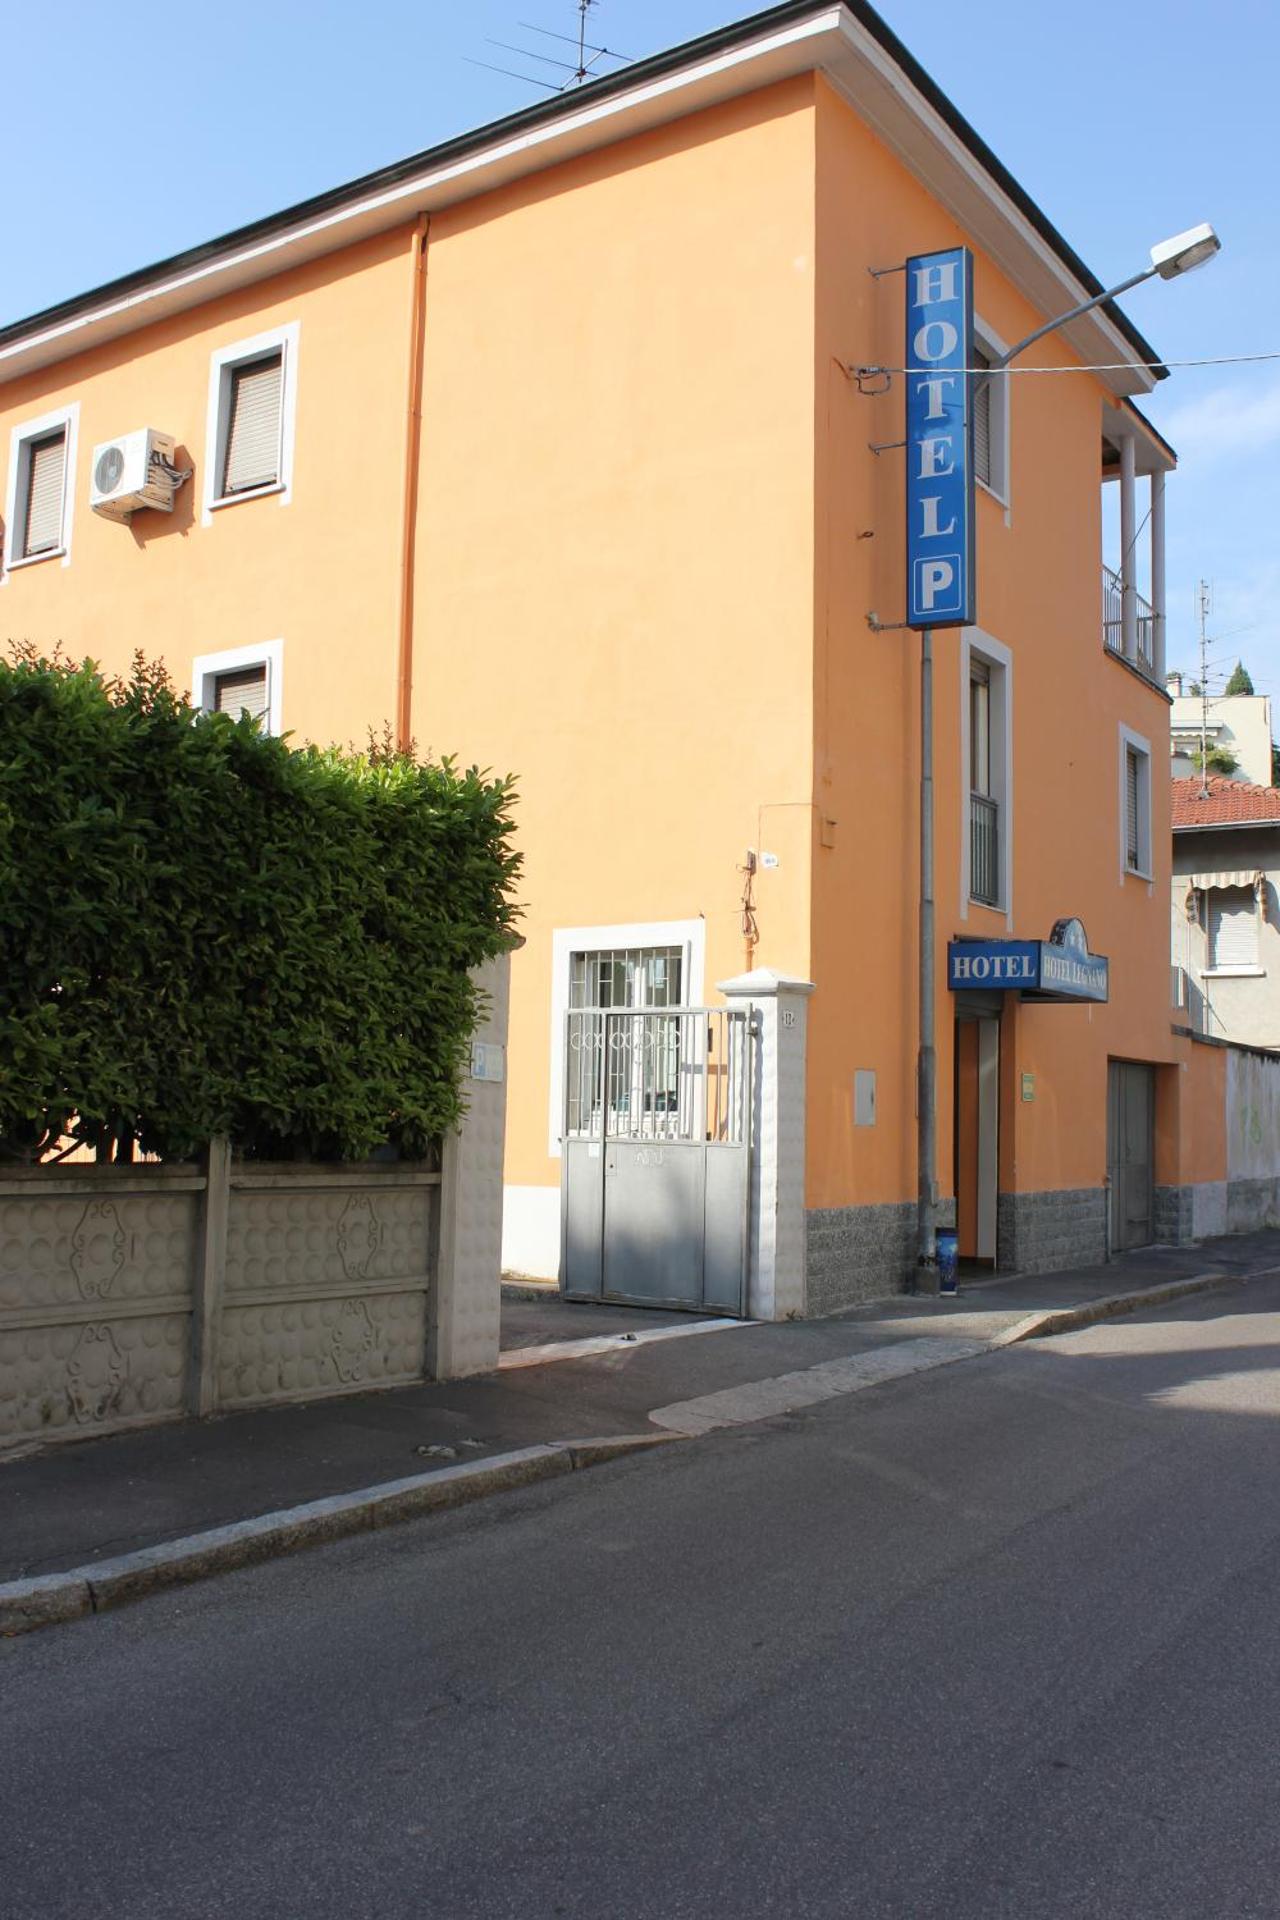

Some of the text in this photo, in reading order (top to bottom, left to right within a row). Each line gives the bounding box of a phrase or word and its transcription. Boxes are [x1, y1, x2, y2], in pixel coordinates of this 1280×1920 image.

[913, 261, 960, 539] HOTEL
[922, 560, 954, 609] P
[953, 955, 1036, 979] HOTEL
[1043, 955, 1071, 981] HOTEL
